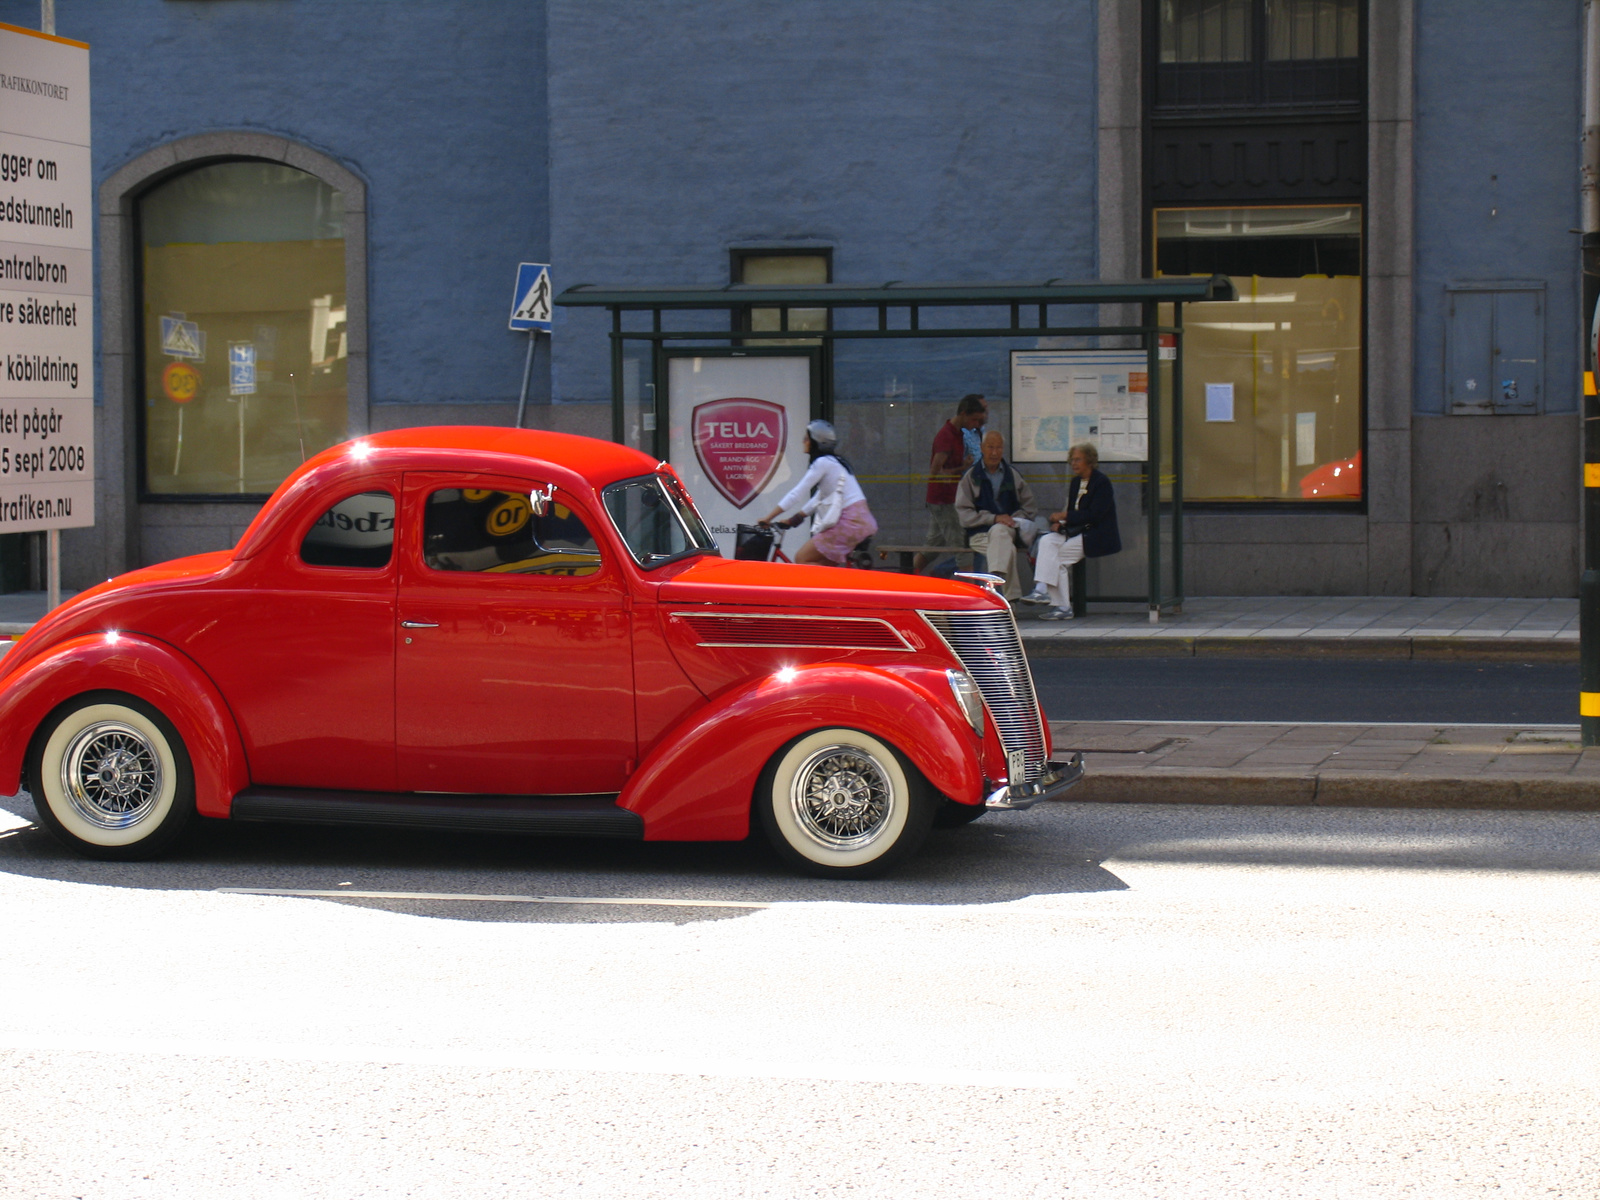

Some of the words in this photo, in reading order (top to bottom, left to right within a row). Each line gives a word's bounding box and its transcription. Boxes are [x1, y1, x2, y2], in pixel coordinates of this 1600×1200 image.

[0, 73, 69, 101] RAFIKKONTORET
[0, 152, 32, 182] gger
[37, 158, 57, 180] om
[0, 196, 73, 229] edstunneln
[18, 297, 77, 327] säkerhet
[7, 354, 79, 389] köbildning
[23, 407, 63, 440] pågår
[704, 422, 774, 438] TELIA
[15, 447, 44, 479] sept
[48, 445, 85, 472] 2008
